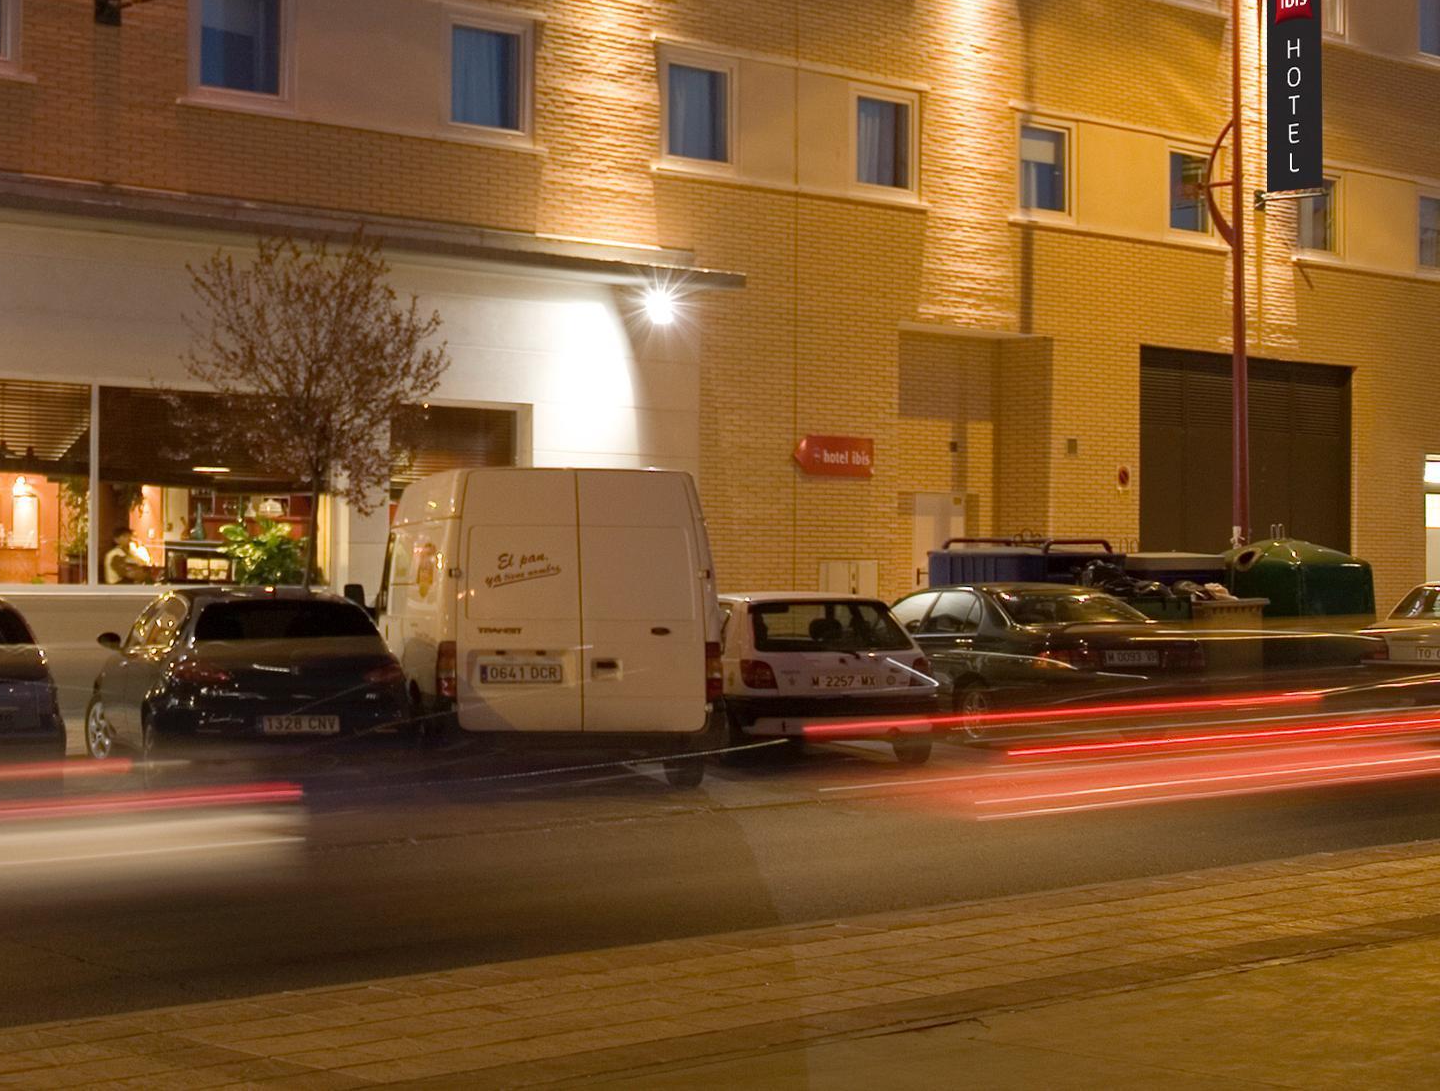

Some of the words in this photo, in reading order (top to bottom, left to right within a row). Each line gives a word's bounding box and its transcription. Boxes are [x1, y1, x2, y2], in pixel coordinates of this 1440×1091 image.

[1286, 37, 1302, 174] HOTEL
[822, 449, 849, 465] hotel
[851, 450, 871, 466] ibis
[497, 552, 514, 571] El
[490, 666, 525, 680] 0641
[530, 666, 558, 679] DCR
[825, 676, 855, 687] 2257
[861, 675, 876, 686] MX
